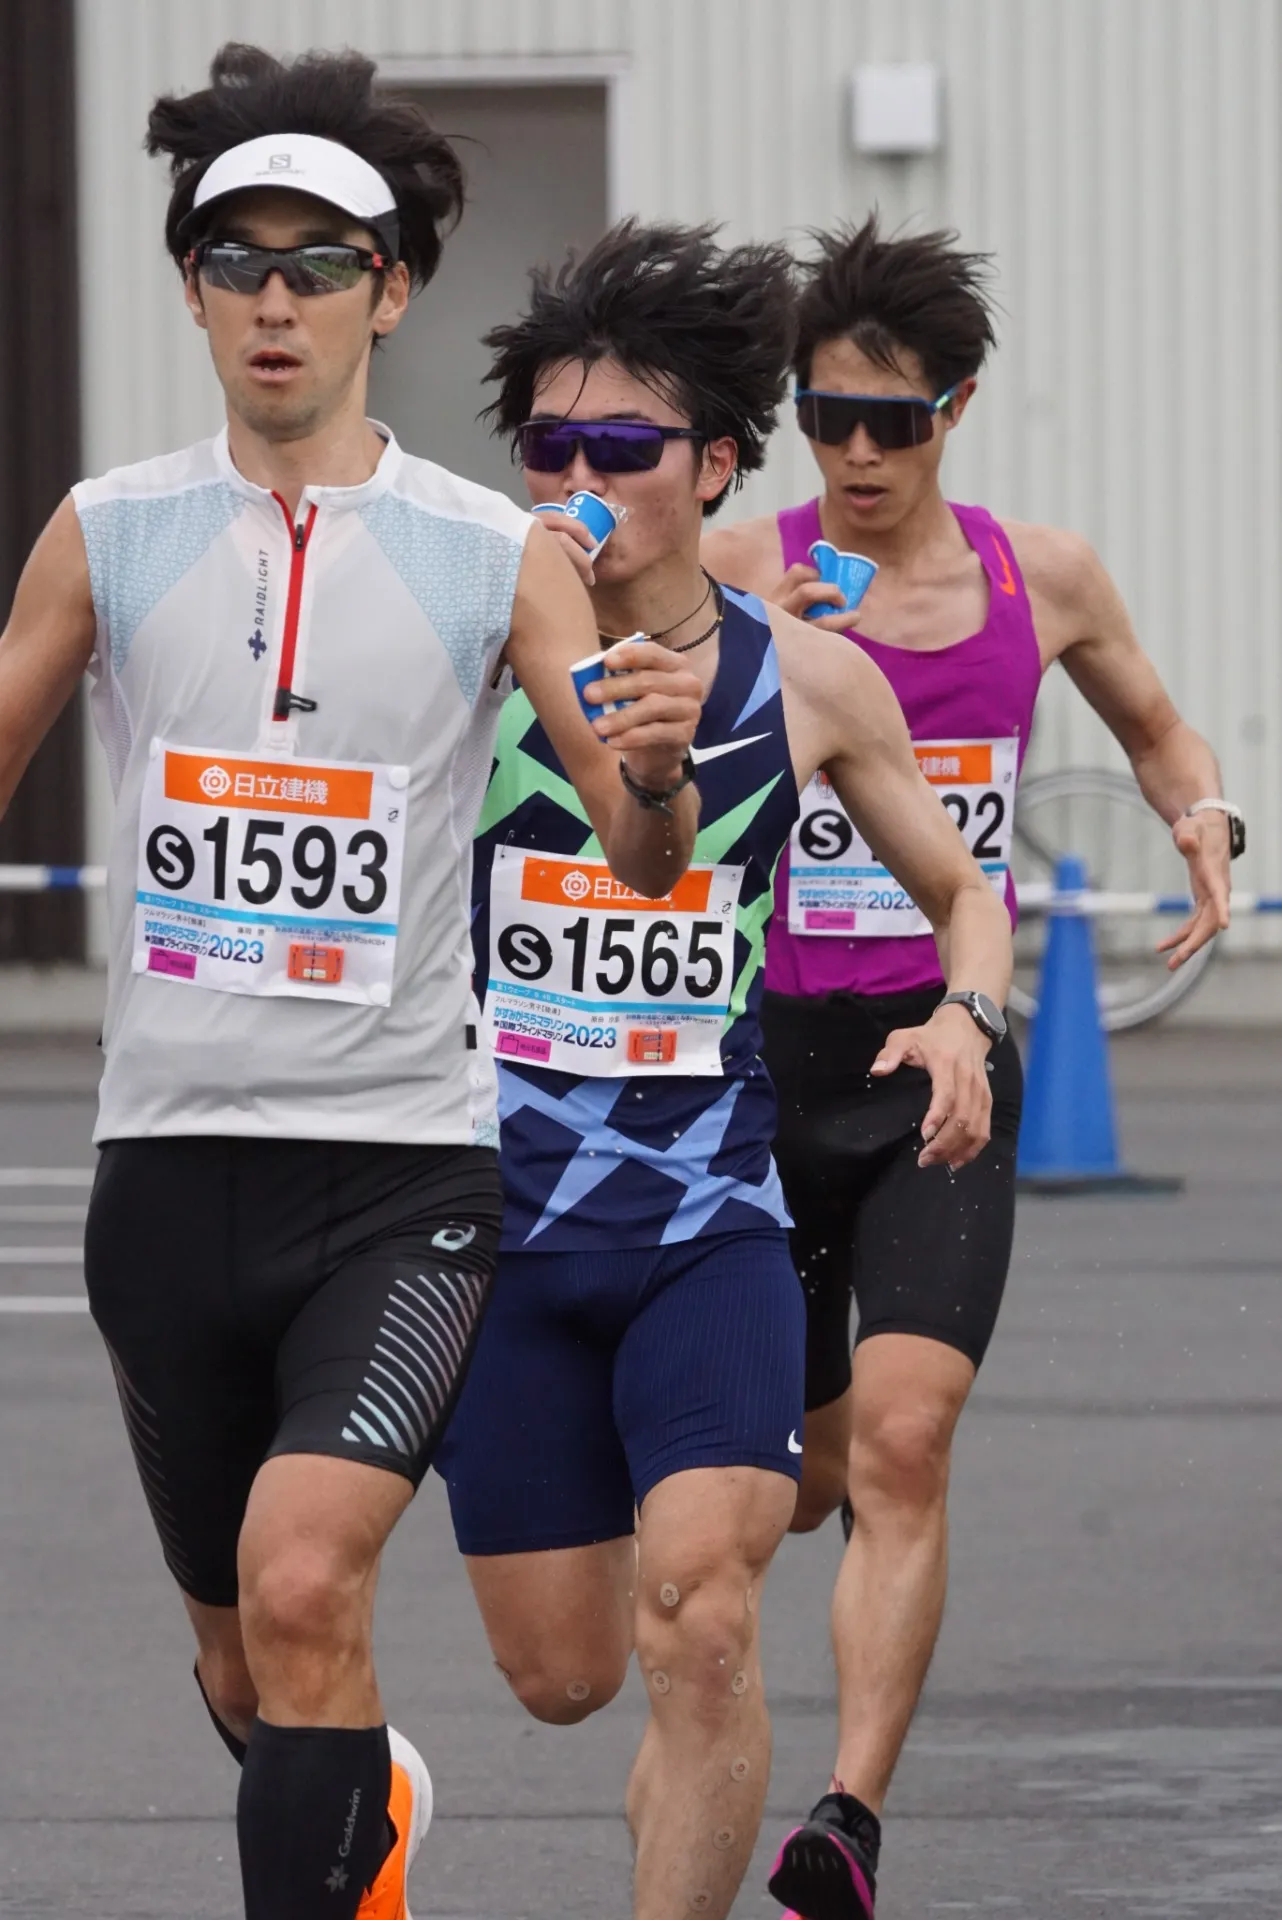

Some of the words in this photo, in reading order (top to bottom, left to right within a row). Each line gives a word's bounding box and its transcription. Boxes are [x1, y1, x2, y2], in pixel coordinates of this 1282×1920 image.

[254, 549, 270, 626] RAIDLIGHT
[234, 773, 329, 806] 日立建機
[203, 815, 389, 915] 1593
[207, 934, 265, 964] 2023
[562, 916, 724, 999] 1565
[563, 1022, 617, 1049] 2023
[338, 1787, 362, 1858] Goldwin
